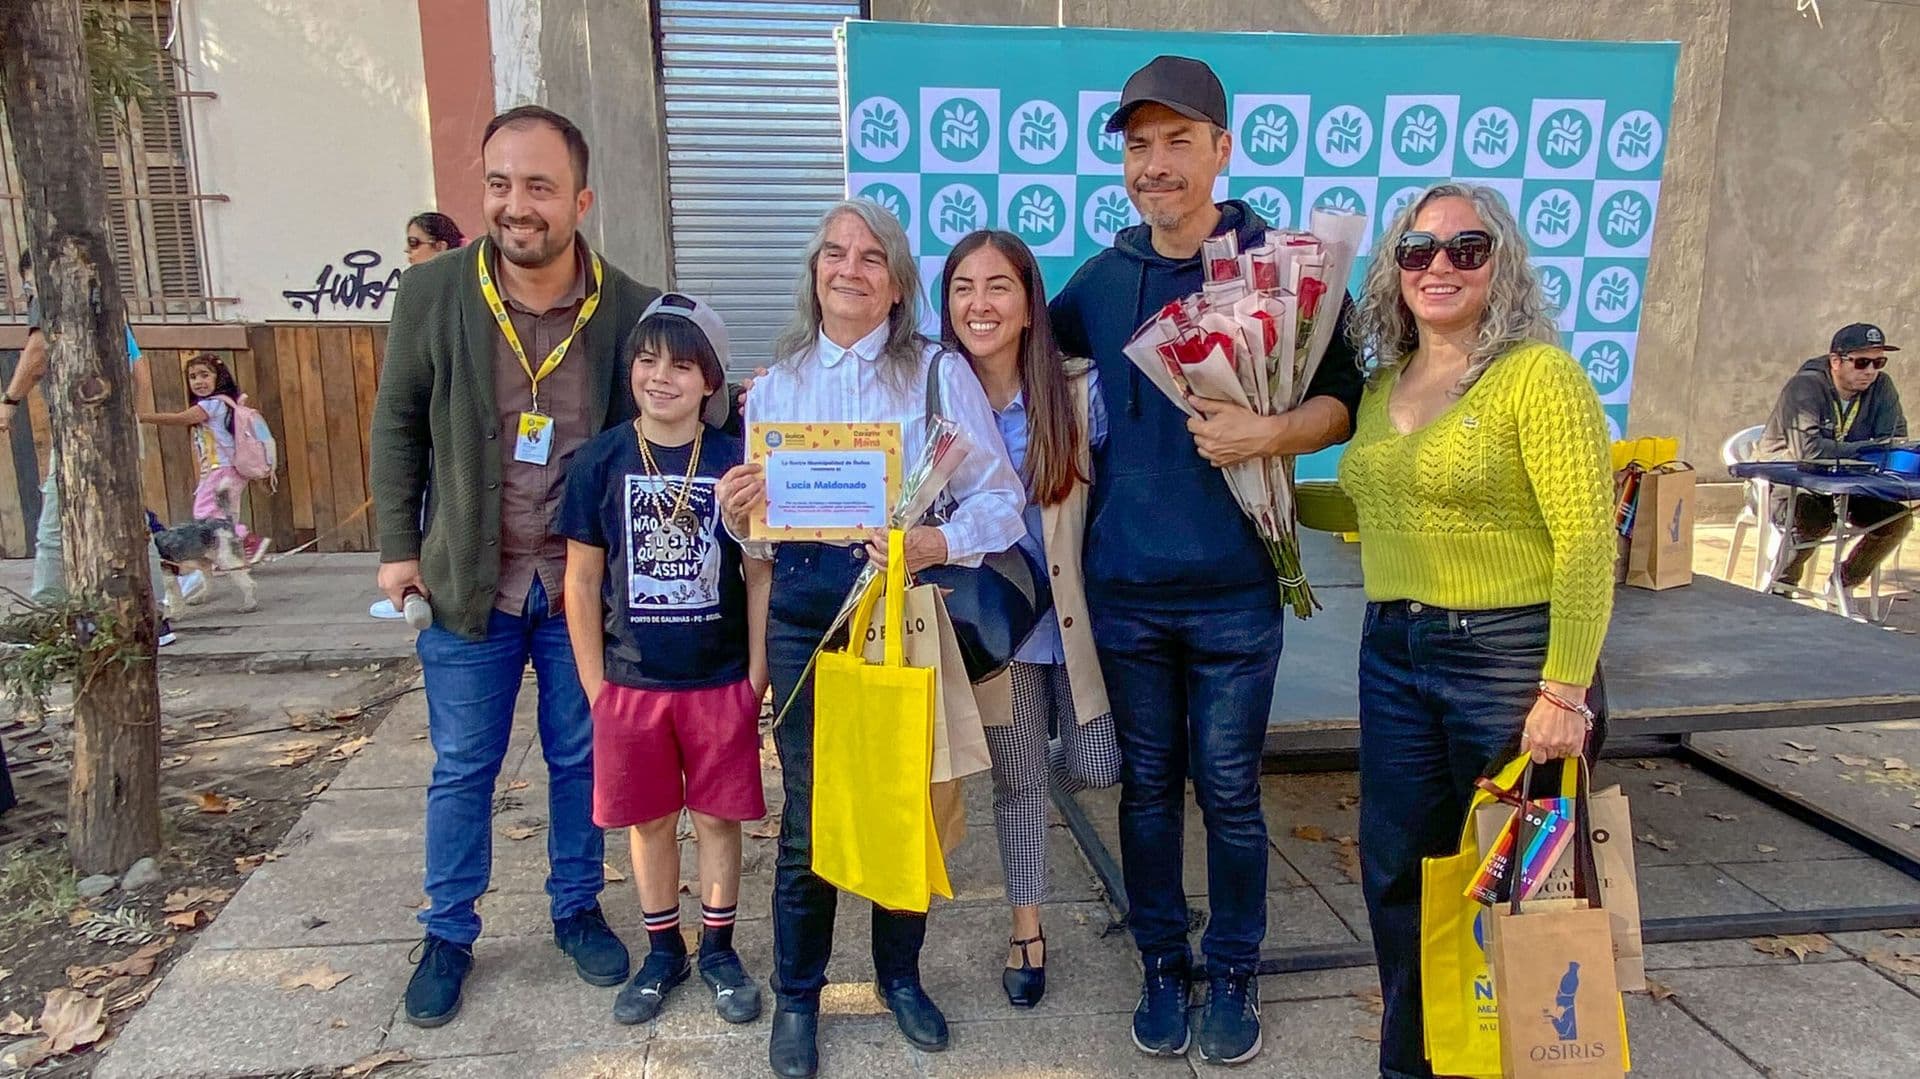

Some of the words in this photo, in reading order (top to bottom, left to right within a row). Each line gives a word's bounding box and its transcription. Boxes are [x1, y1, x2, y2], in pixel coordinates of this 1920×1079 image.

[814, 480, 866, 489] Maldonado
[633, 515, 659, 532] NÃO
[652, 562, 698, 577] ASSIM
[630, 615, 651, 623] PORTO
[866, 617, 925, 642] ÓBLO
[1525, 813, 1557, 833] BOLO
[1529, 1041, 1606, 1062] OSIRIS
